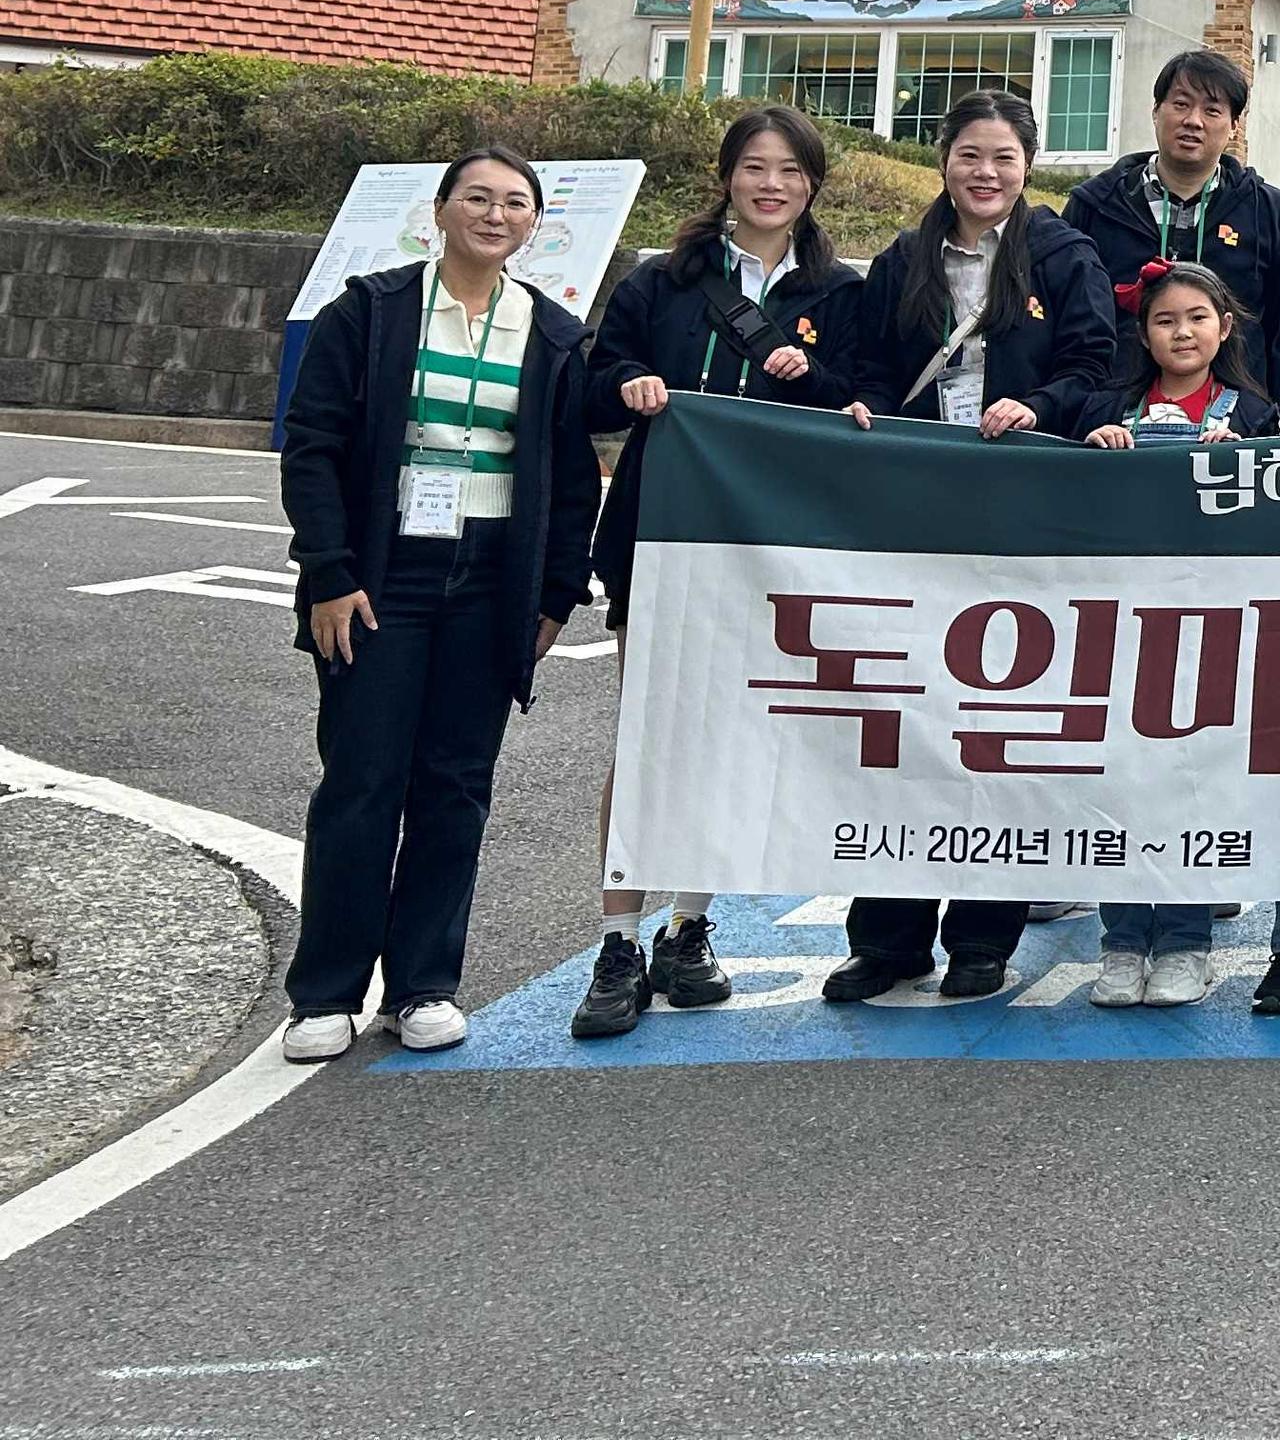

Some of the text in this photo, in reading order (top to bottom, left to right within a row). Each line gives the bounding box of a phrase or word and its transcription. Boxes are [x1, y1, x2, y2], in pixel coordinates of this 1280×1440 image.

[832, 823, 1253, 868] 일시: 2024년 11월 ~ 12월
